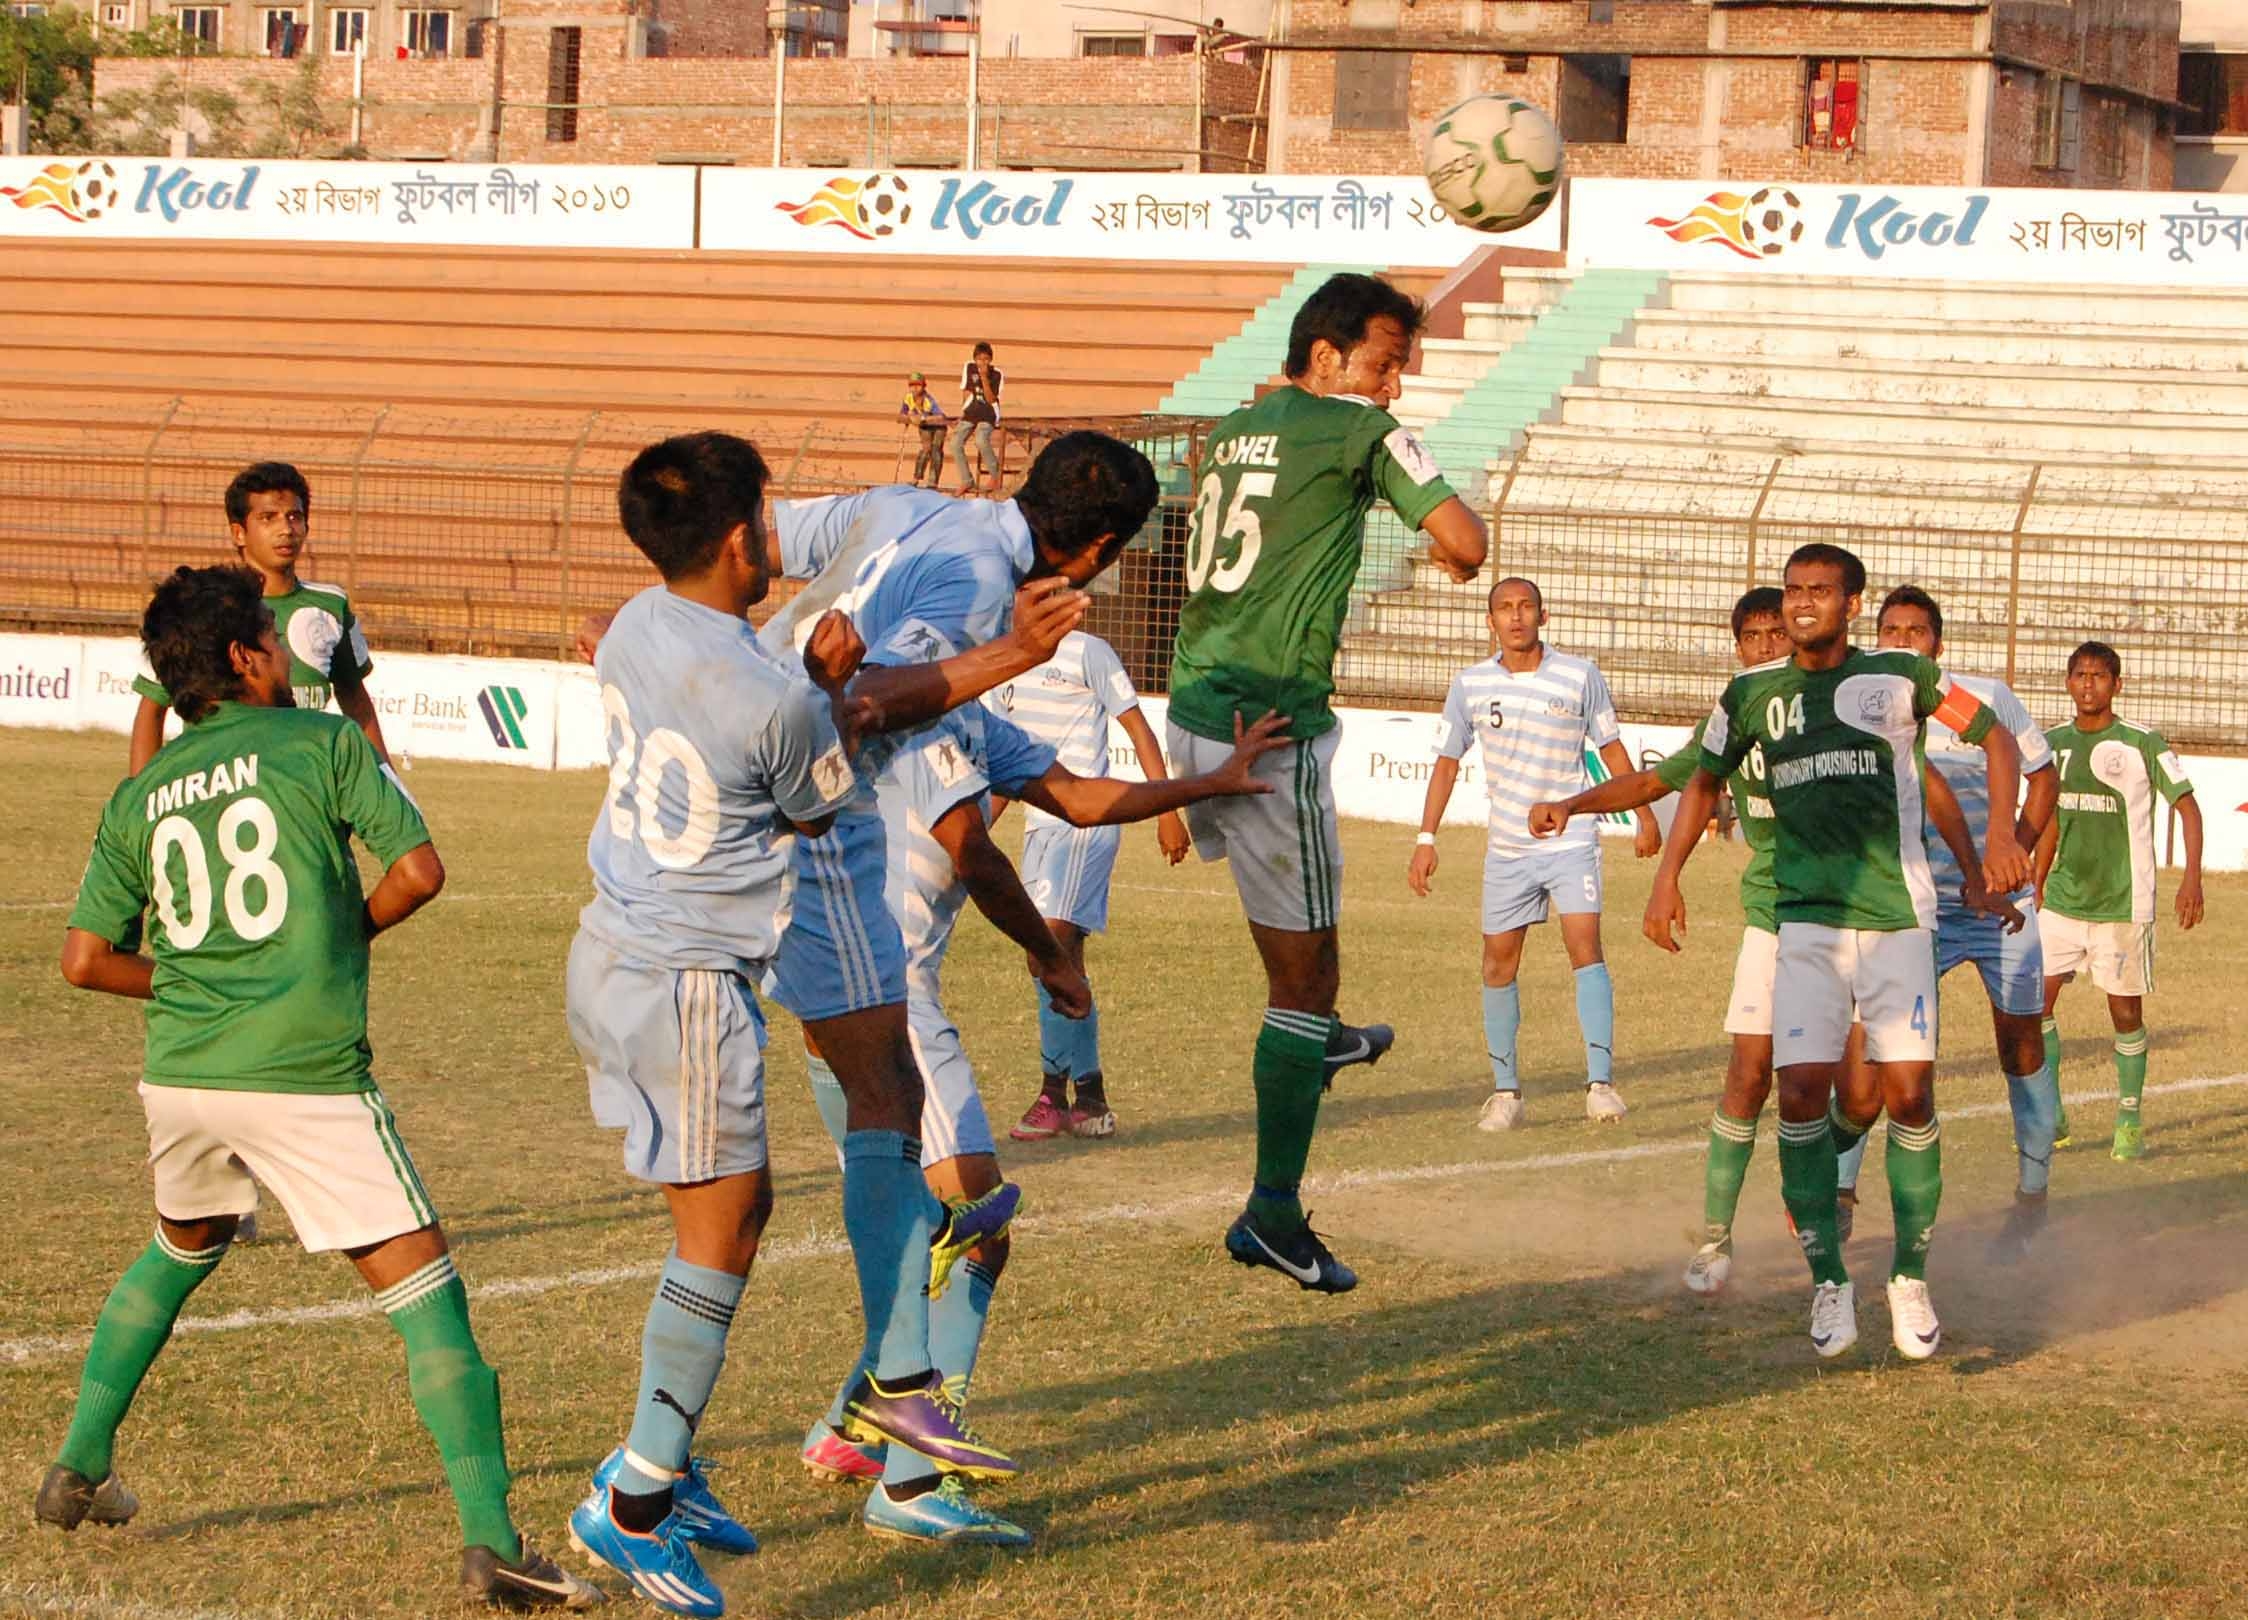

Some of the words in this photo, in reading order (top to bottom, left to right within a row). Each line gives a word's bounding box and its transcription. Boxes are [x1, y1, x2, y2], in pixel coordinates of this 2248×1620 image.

[134, 165, 260, 223] Kool
[275, 187, 308, 215] ২য়
[313, 179, 381, 215] বিভাগ
[391, 169, 479, 224] ফুটবল
[486, 168, 540, 215] লীগ
[552, 183, 631, 213] ২০১৩
[930, 178, 1074, 240] Kool
[1091, 202, 1128, 231] ২য়
[1135, 194, 1210, 231] বিভাগ
[1222, 181, 1324, 240] ফুটবল
[1331, 179, 1393, 231] লীগ
[1406, 197, 1448, 228] ২০
[1825, 193, 1990, 260] Kool
[2009, 220, 2051, 252] ২য়
[2060, 212, 2147, 252] বিভাগ
[2160, 200, 2248, 263] ফুটব
[1208, 435, 1280, 467] OHEL
[1186, 471, 1278, 593] 05
[412, 692, 468, 719] Bank
[1490, 701, 1503, 729] 5
[1766, 692, 1806, 741] 04
[146, 754, 258, 822] IMRAN
[1815, 750, 1857, 778] HOUSING
[151, 796, 288, 950] 08
[1583, 874, 1597, 902] 5
[2115, 952, 2128, 980] 7
[1910, 994, 1928, 1040] 4
